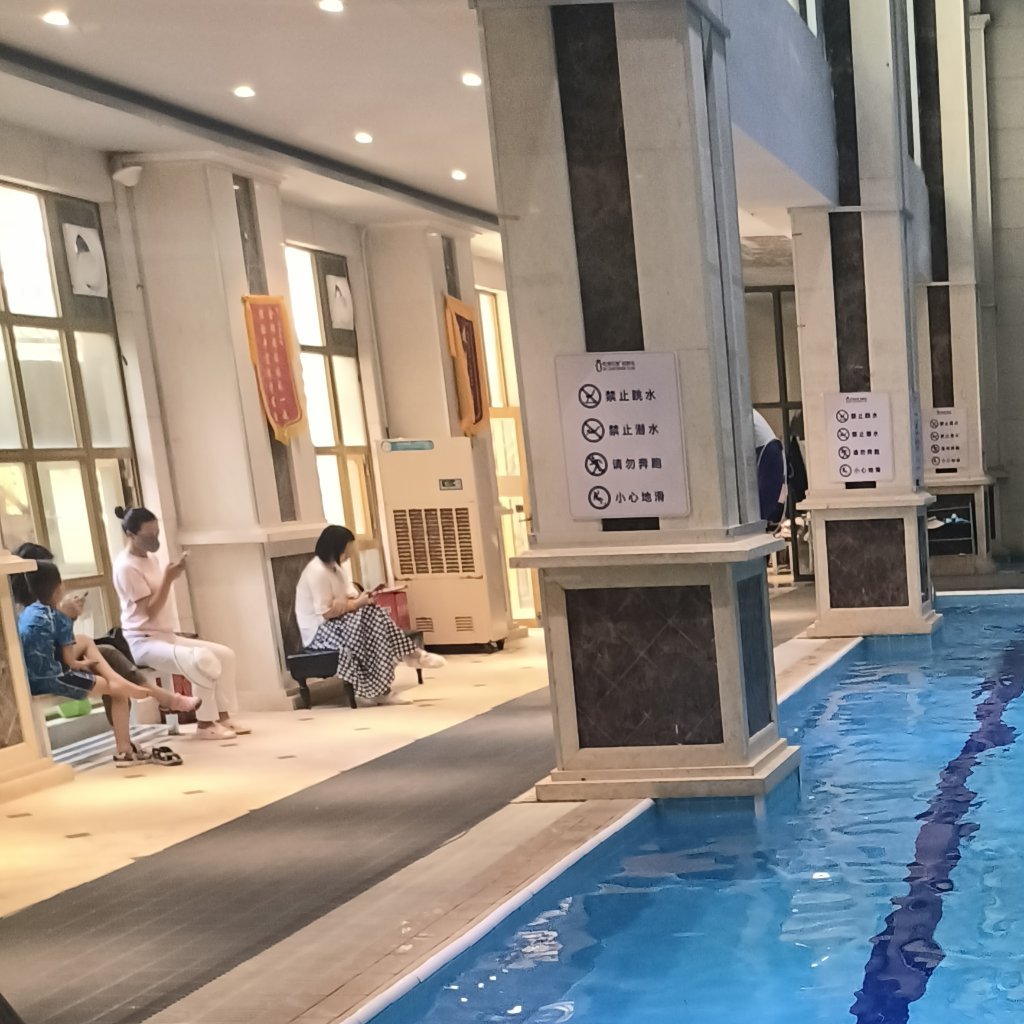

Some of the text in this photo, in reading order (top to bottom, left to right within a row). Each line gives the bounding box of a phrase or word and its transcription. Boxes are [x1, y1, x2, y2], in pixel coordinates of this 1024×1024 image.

[605, 388, 657, 402] 禁止跳水
[608, 423, 660, 437] 禁止潜水
[615, 491, 665, 504] 小心地滑
